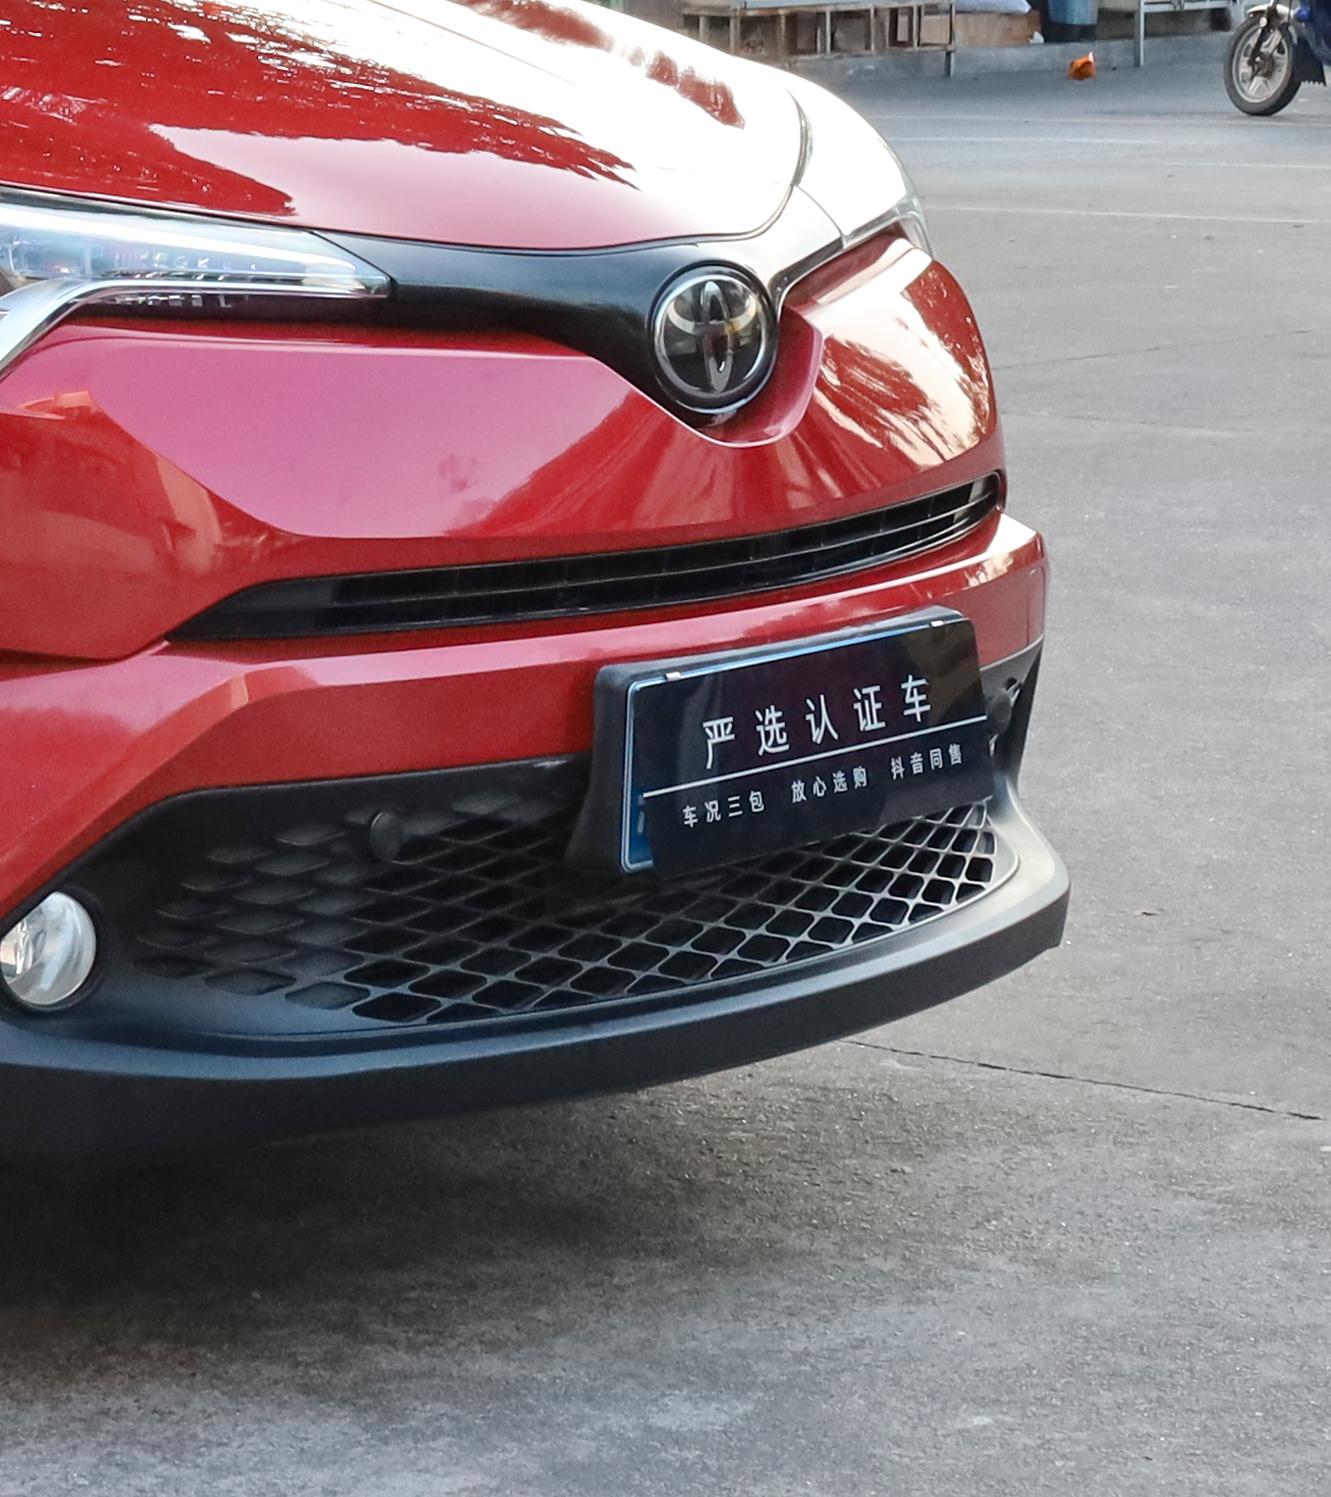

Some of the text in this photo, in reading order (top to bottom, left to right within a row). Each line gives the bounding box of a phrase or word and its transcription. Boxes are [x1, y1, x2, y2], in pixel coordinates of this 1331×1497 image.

[701, 674, 933, 770] 严选认证车
[681, 742, 963, 829] 车况三包 放心选购 抖音同售
